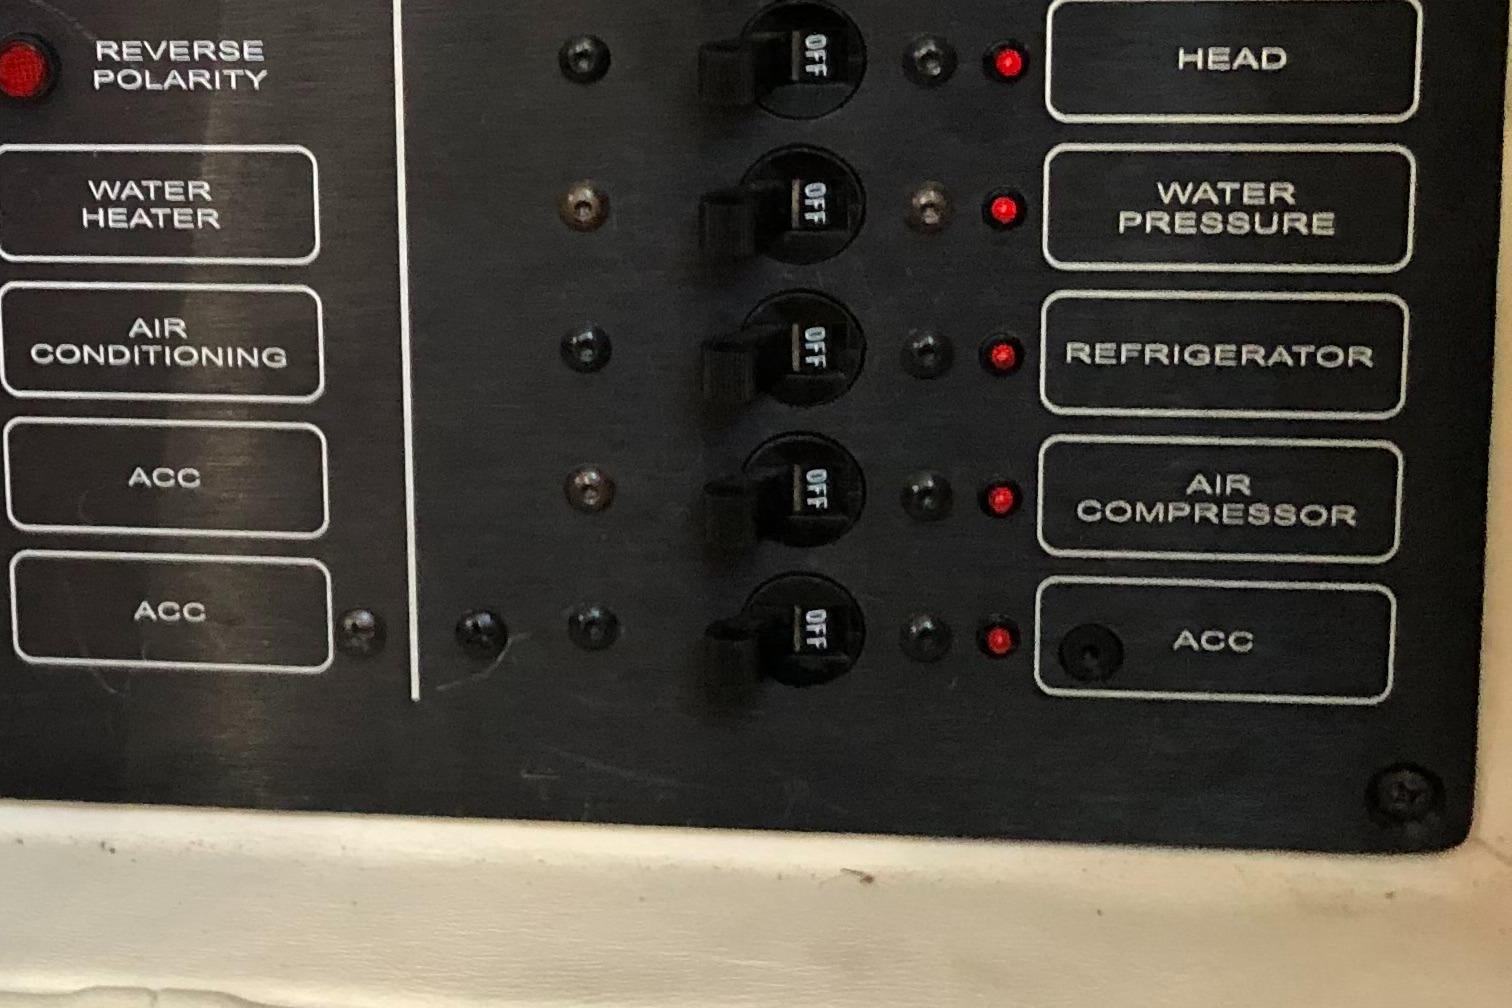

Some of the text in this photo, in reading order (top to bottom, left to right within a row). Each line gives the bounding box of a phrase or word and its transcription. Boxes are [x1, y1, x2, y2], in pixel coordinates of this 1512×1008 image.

[96, 39, 265, 62] REVERSE
[804, 33, 828, 77] OFF
[1178, 46, 1287, 72] HEAD
[93, 68, 268, 90] POLARITY
[87, 180, 213, 202] WATER
[804, 182, 827, 224] OFF
[1156, 181, 1296, 206] WATER
[82, 207, 221, 230] HEATER
[1118, 210, 1335, 236] PRESSURE
[128, 317, 188, 339] AIR
[30, 343, 287, 369] CONDITIONING
[804, 326, 827, 368] OFF
[1066, 341, 1374, 368] REFRIGERATOR
[128, 466, 201, 489] ACC
[805, 468, 828, 509] OFF
[1186, 473, 1251, 496] AIR
[1076, 499, 1357, 527] COMPRESSOR
[134, 600, 207, 623] ACC
[805, 608, 828, 649] OFF
[1173, 629, 1254, 653] ACC
